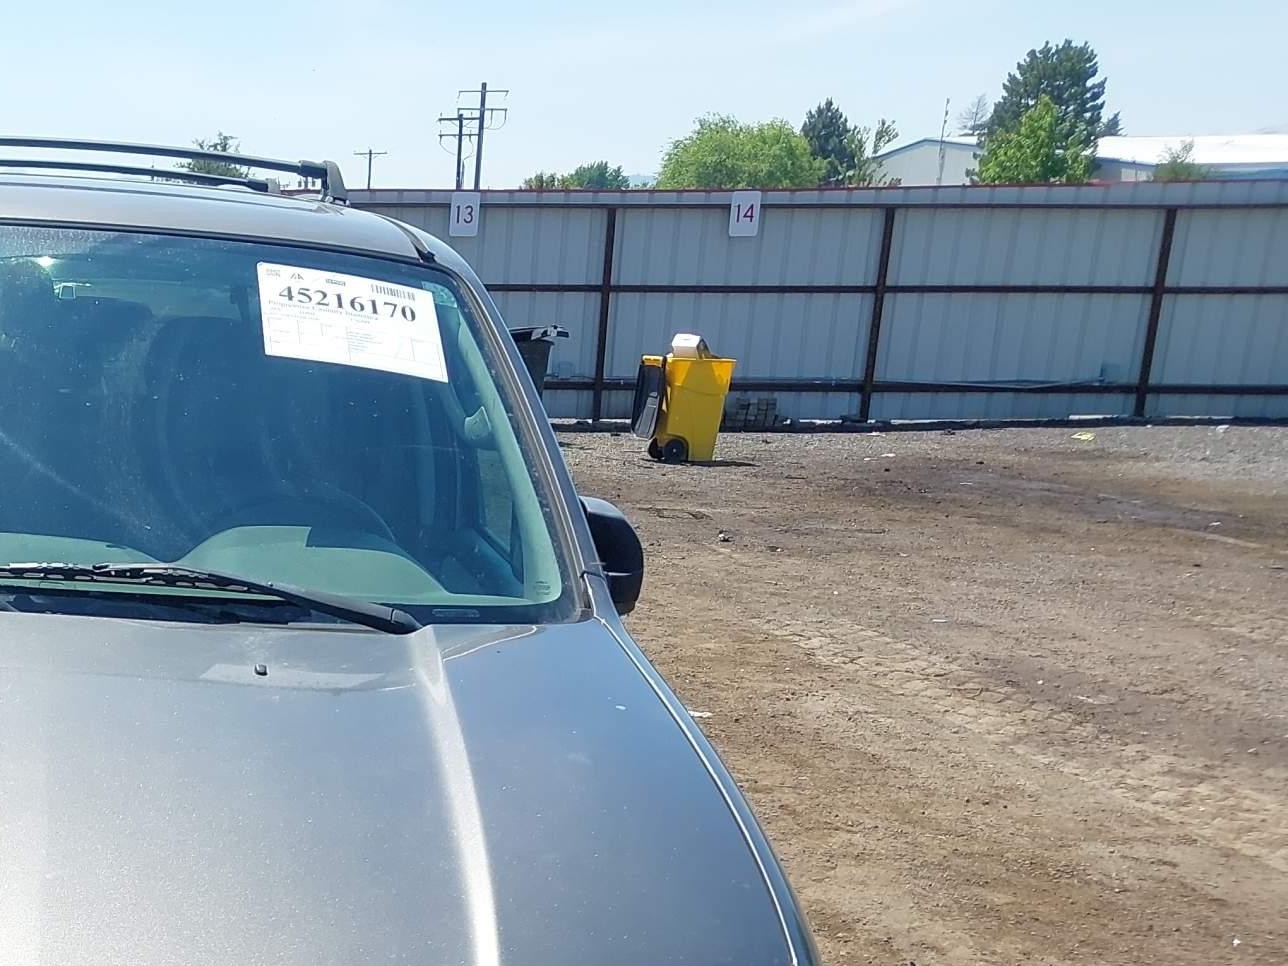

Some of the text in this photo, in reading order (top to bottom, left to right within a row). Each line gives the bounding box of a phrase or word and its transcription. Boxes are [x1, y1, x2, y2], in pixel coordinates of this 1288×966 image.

[455, 204, 474, 224] 13
[734, 203, 755, 223] 14
[278, 285, 417, 323] 45216170
